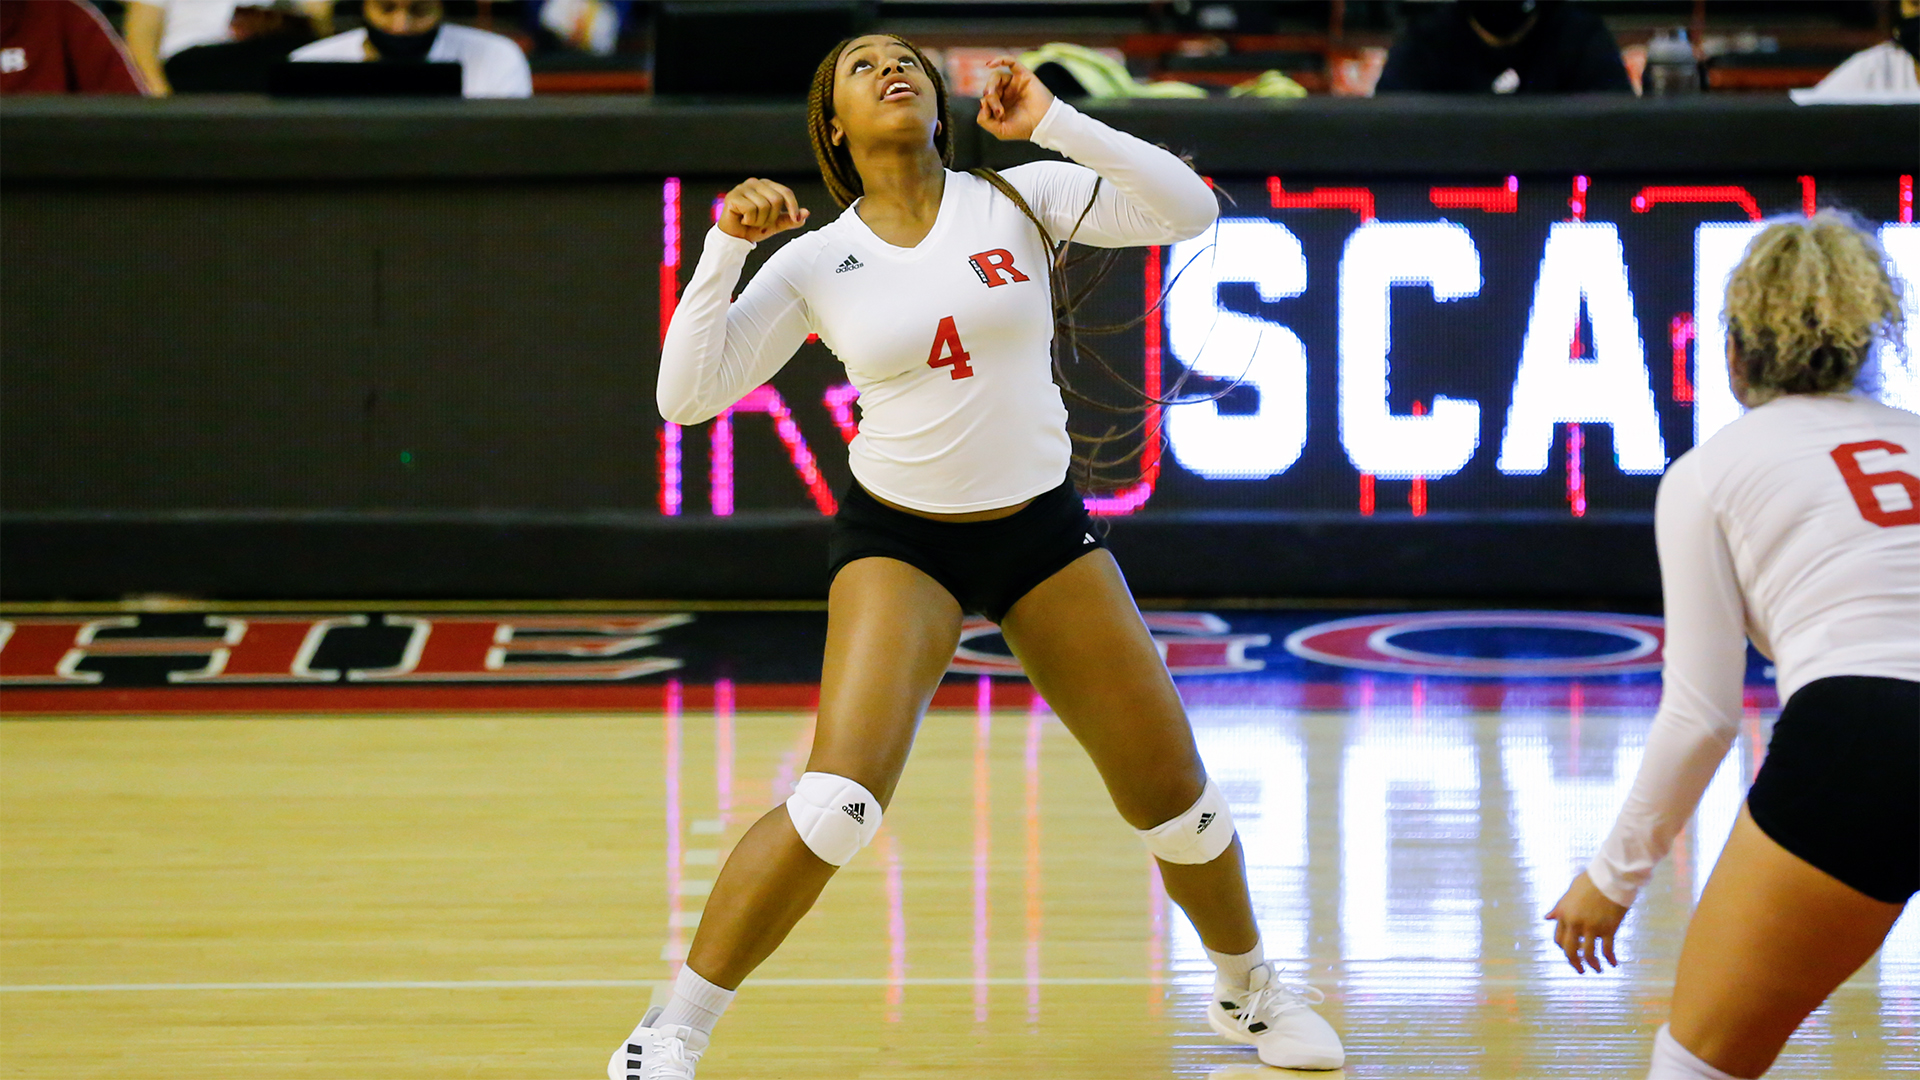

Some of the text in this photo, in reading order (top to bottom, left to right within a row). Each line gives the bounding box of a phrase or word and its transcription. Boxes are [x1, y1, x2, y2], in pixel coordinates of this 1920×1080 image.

[835, 262, 865, 274] adidas
[926, 315, 974, 381] 4
[1829, 439, 1920, 528] 6
[841, 805, 865, 825] adidas
